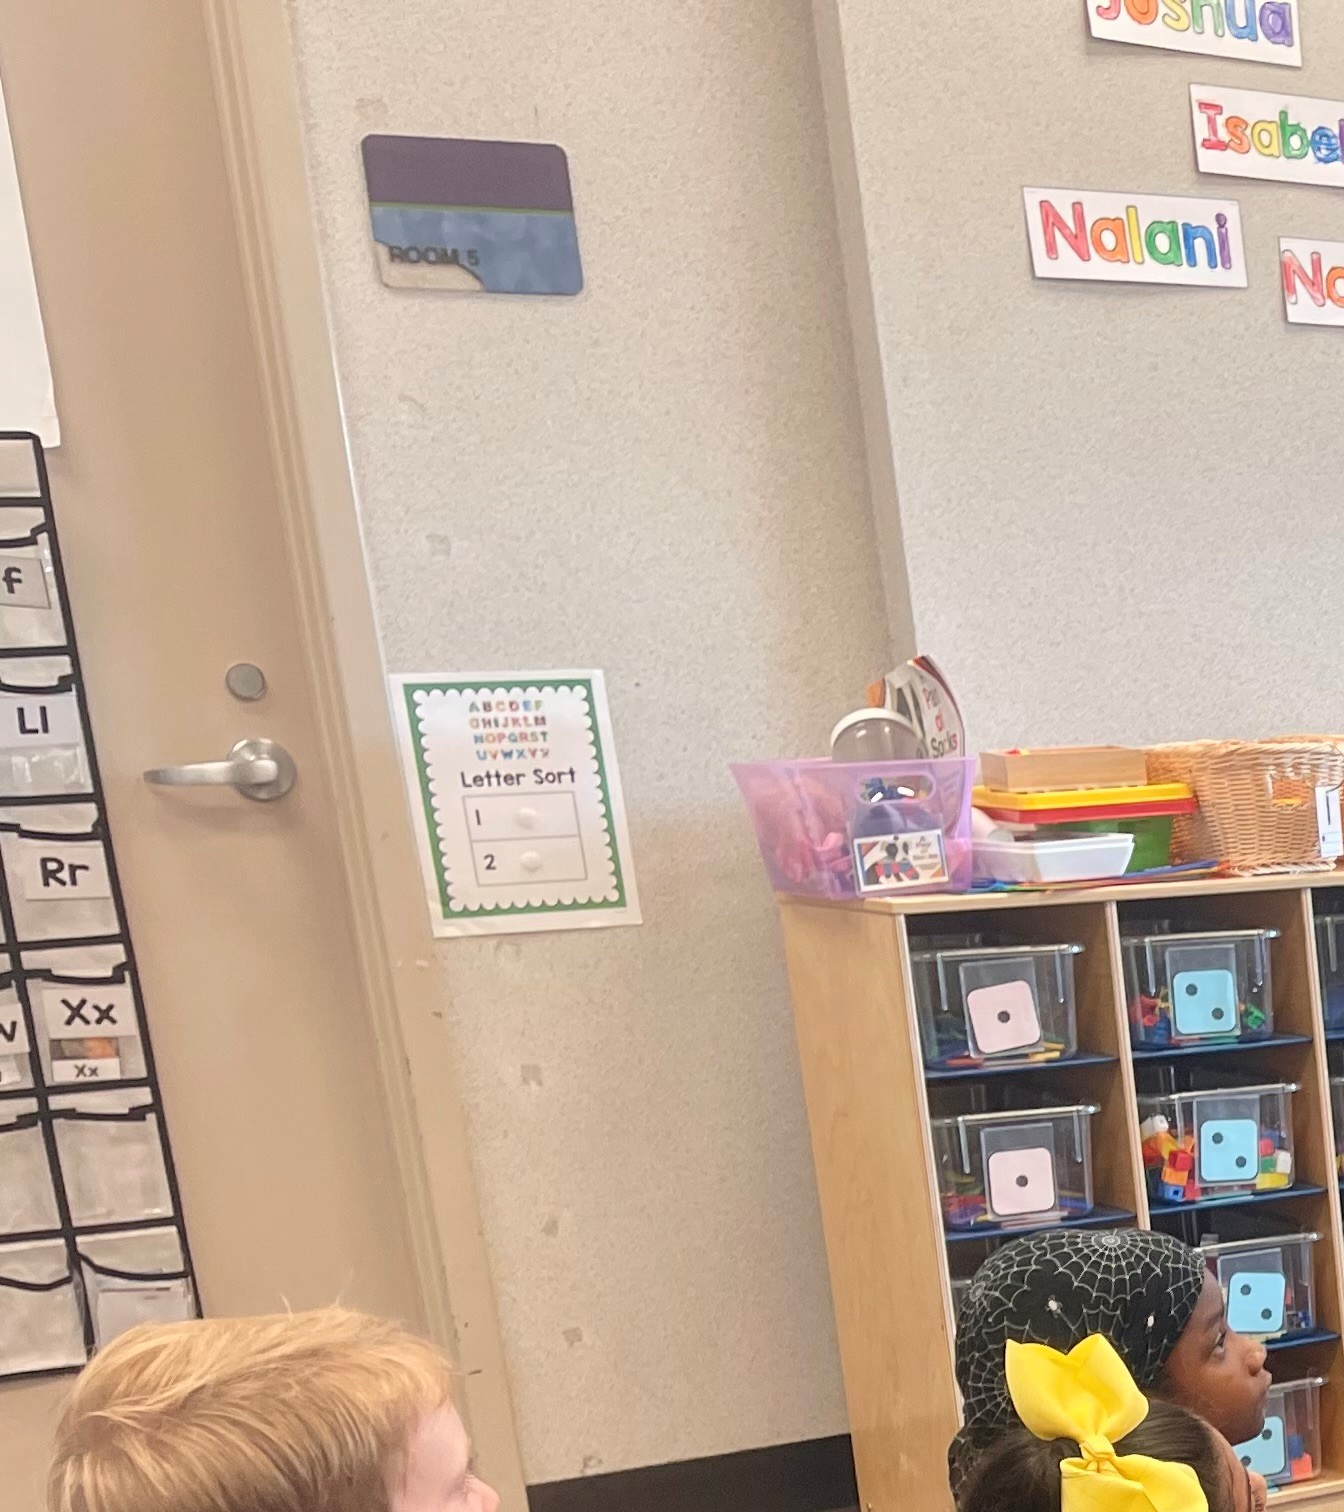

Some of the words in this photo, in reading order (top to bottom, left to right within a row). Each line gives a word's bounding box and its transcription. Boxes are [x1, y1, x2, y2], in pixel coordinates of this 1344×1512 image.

[1039, 200, 1233, 270] Nalani
[388, 246, 459, 264] ROOM
[467, 248, 480, 266] 5
[461, 769, 526, 788] Letter
[532, 767, 576, 785] Sort
[40, 857, 90, 887] Rr
[483, 853, 497, 871] 2
[60, 998, 118, 1026] Xx
[74, 1064, 98, 1078] Xx
